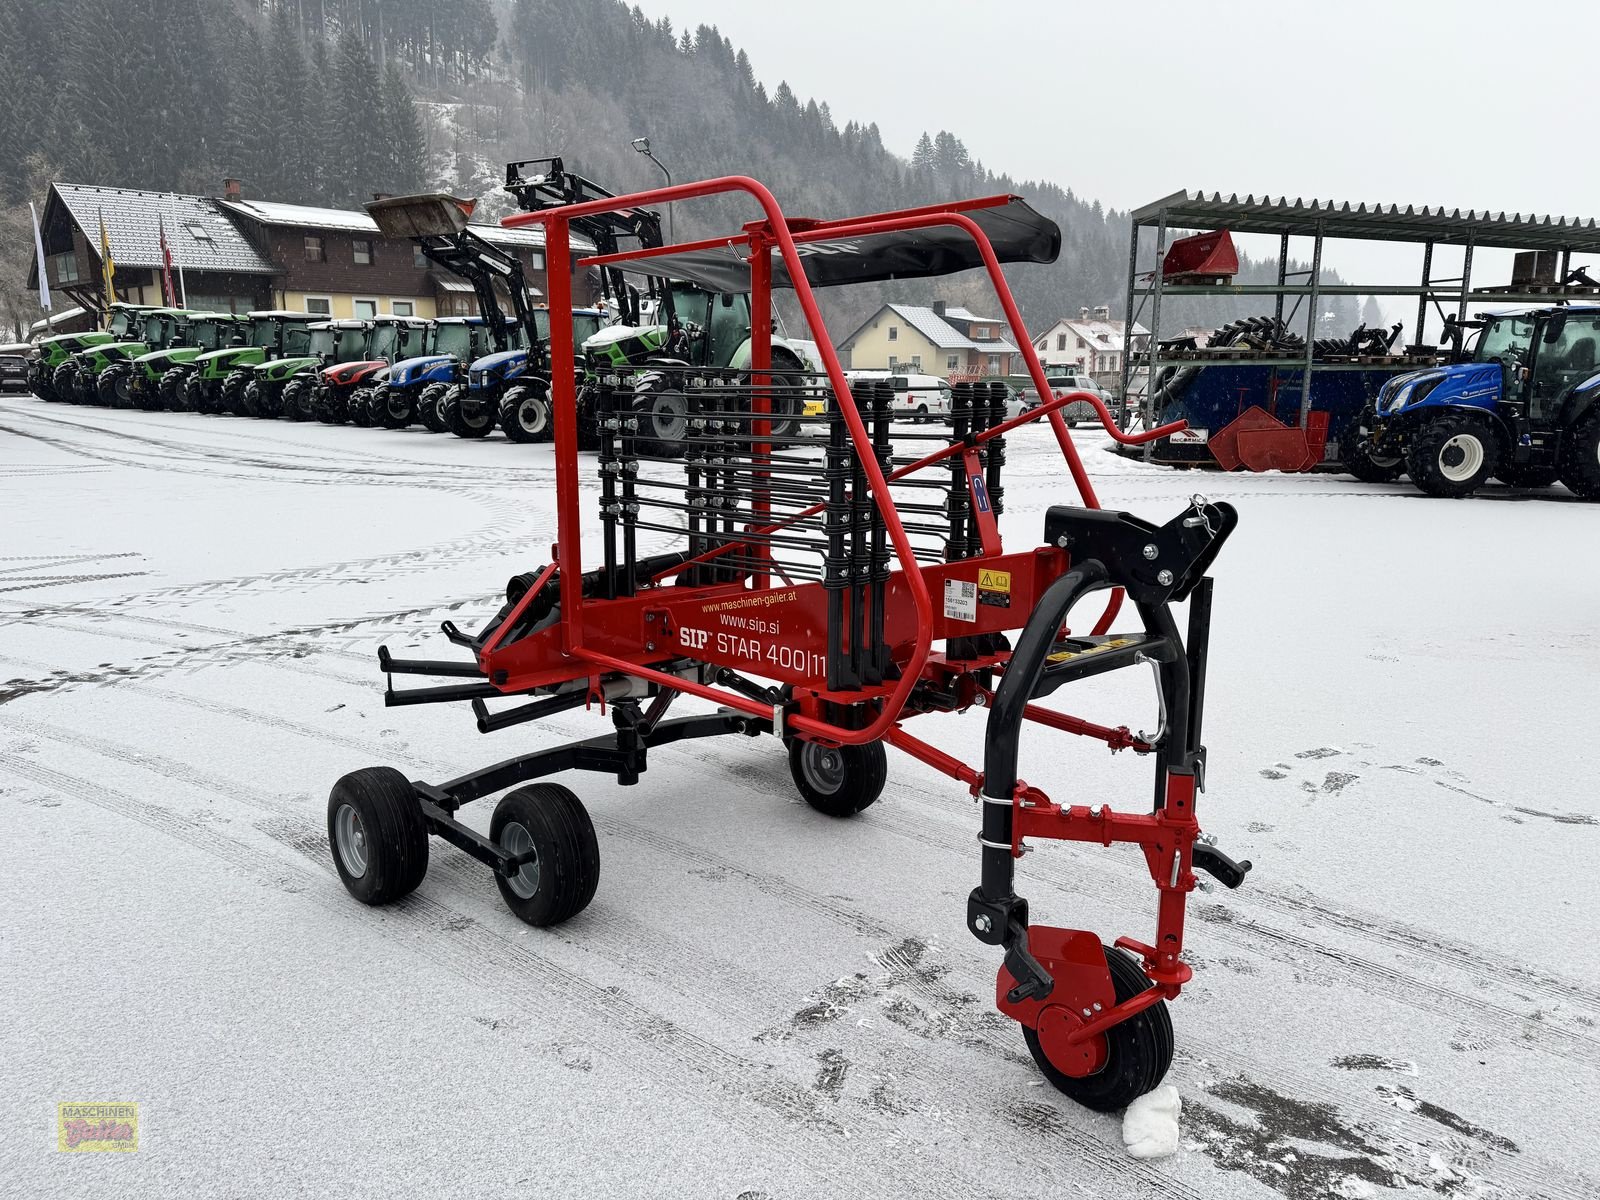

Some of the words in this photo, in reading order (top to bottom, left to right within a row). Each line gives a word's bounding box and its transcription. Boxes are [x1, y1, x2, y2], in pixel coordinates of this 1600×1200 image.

[702, 590, 797, 613] www.maschinen-gailer.at
[720, 613, 780, 635] www.sip.si
[717, 632, 761, 662] STAR
